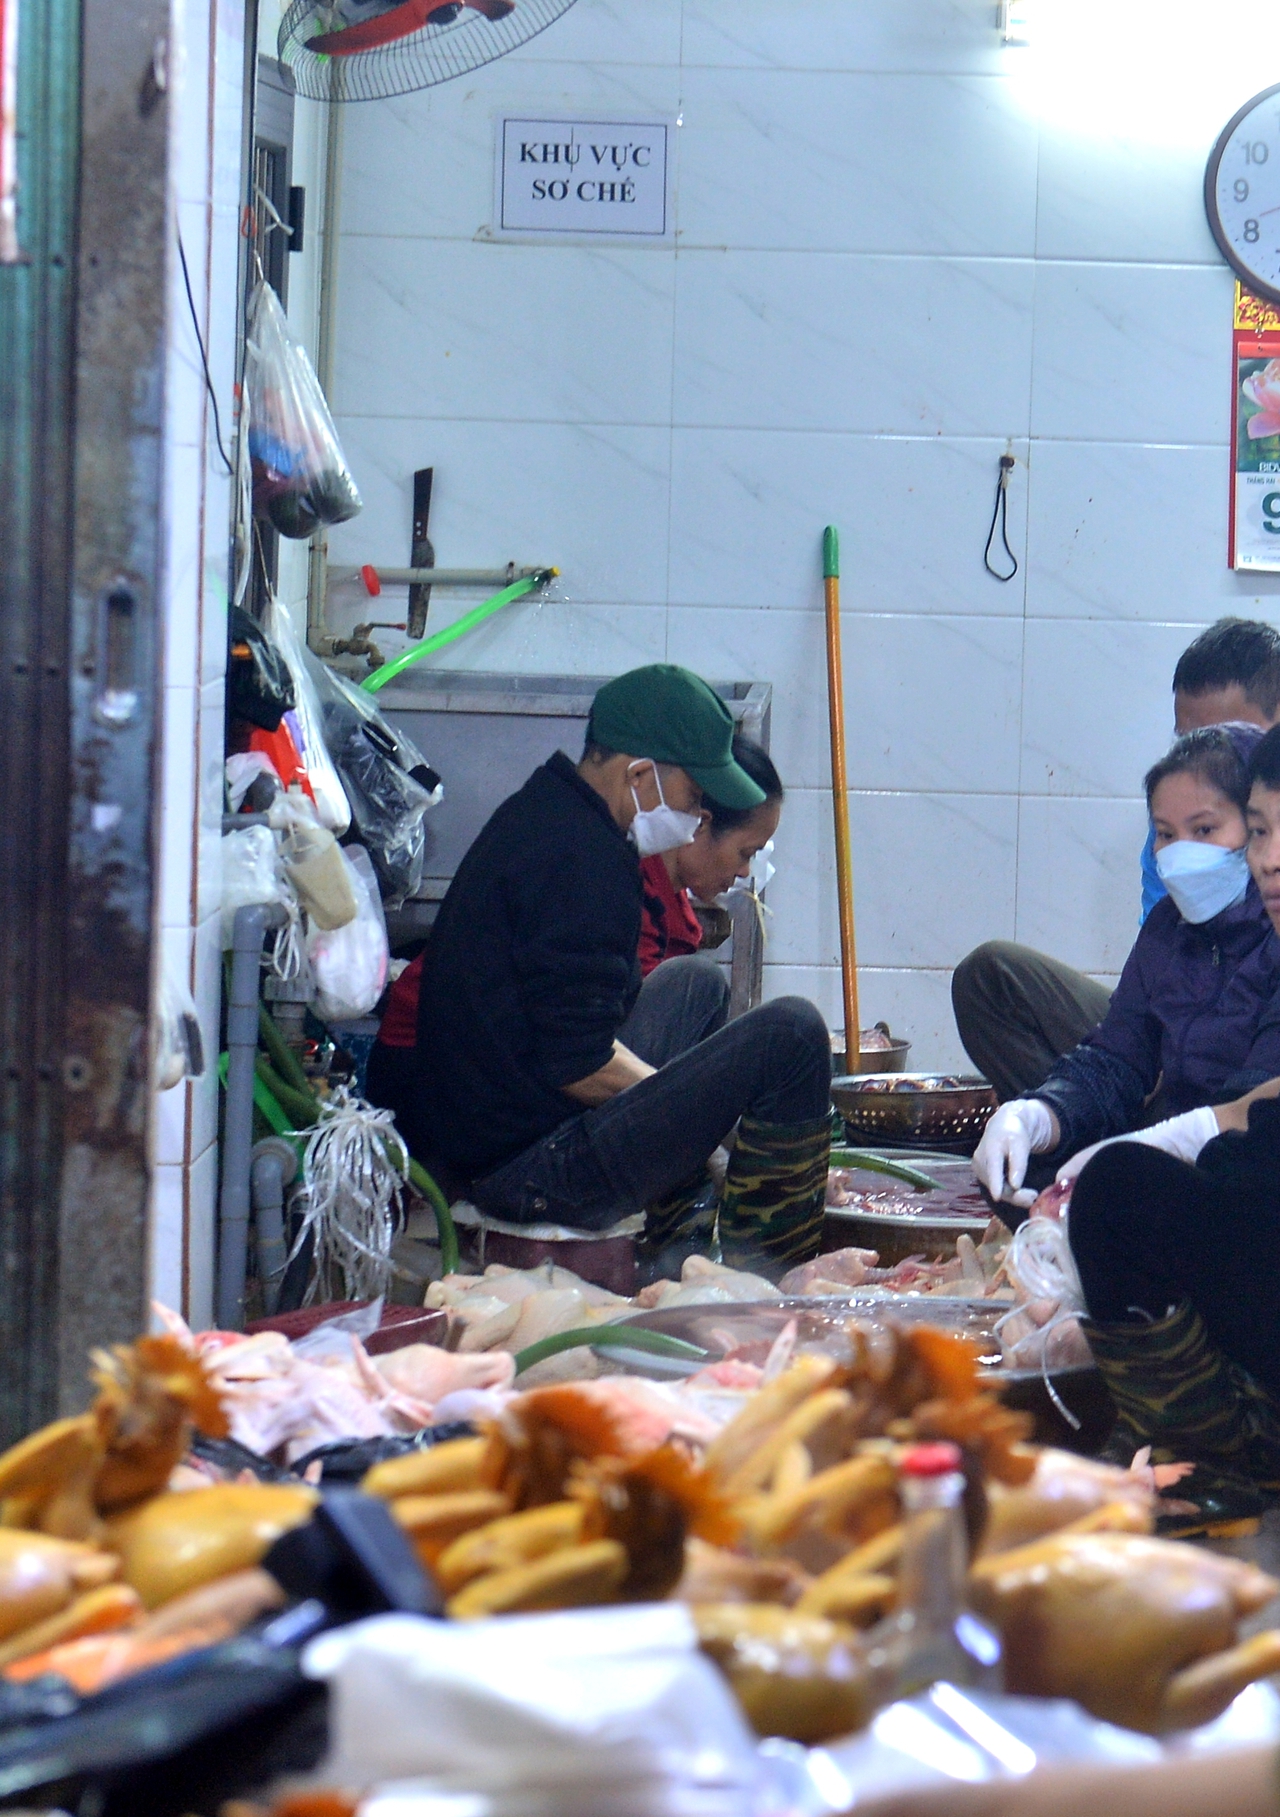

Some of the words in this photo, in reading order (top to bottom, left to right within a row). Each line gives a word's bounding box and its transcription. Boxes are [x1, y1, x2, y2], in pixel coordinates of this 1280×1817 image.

[590, 142, 651, 171] VỰC
[1242, 141, 1269, 165] 10
[532, 179, 570, 201] SƠ
[1233, 178, 1250, 203] 9
[1243, 218, 1260, 243] 8
